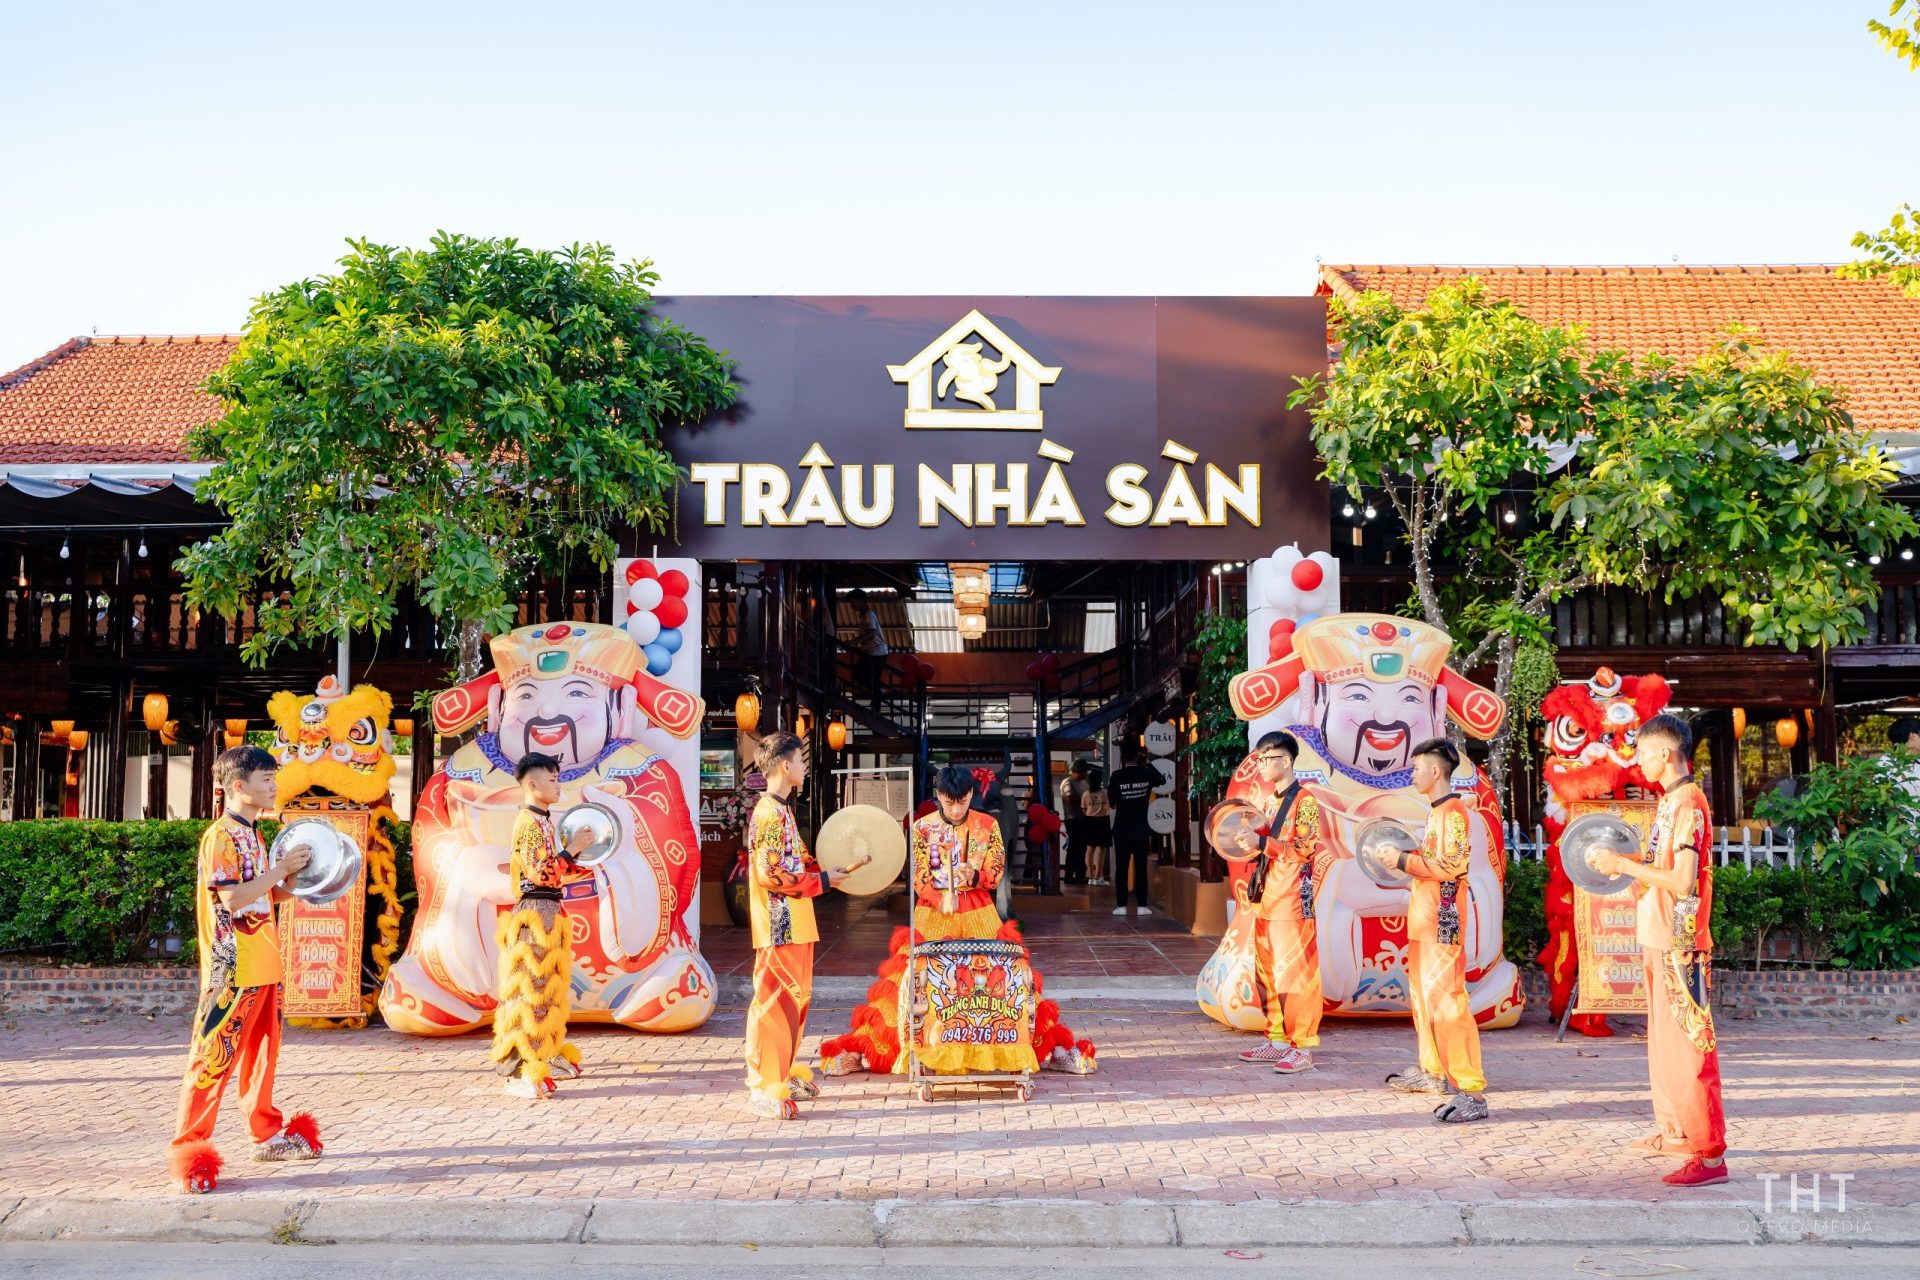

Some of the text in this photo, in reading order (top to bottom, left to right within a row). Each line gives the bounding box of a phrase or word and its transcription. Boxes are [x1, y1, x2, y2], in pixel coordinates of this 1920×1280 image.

[690, 438, 1261, 528] TRÂU NHÀ SÀN
[969, 995, 990, 1010] ANH
[941, 1028, 1018, 1043] 0942 576 999
